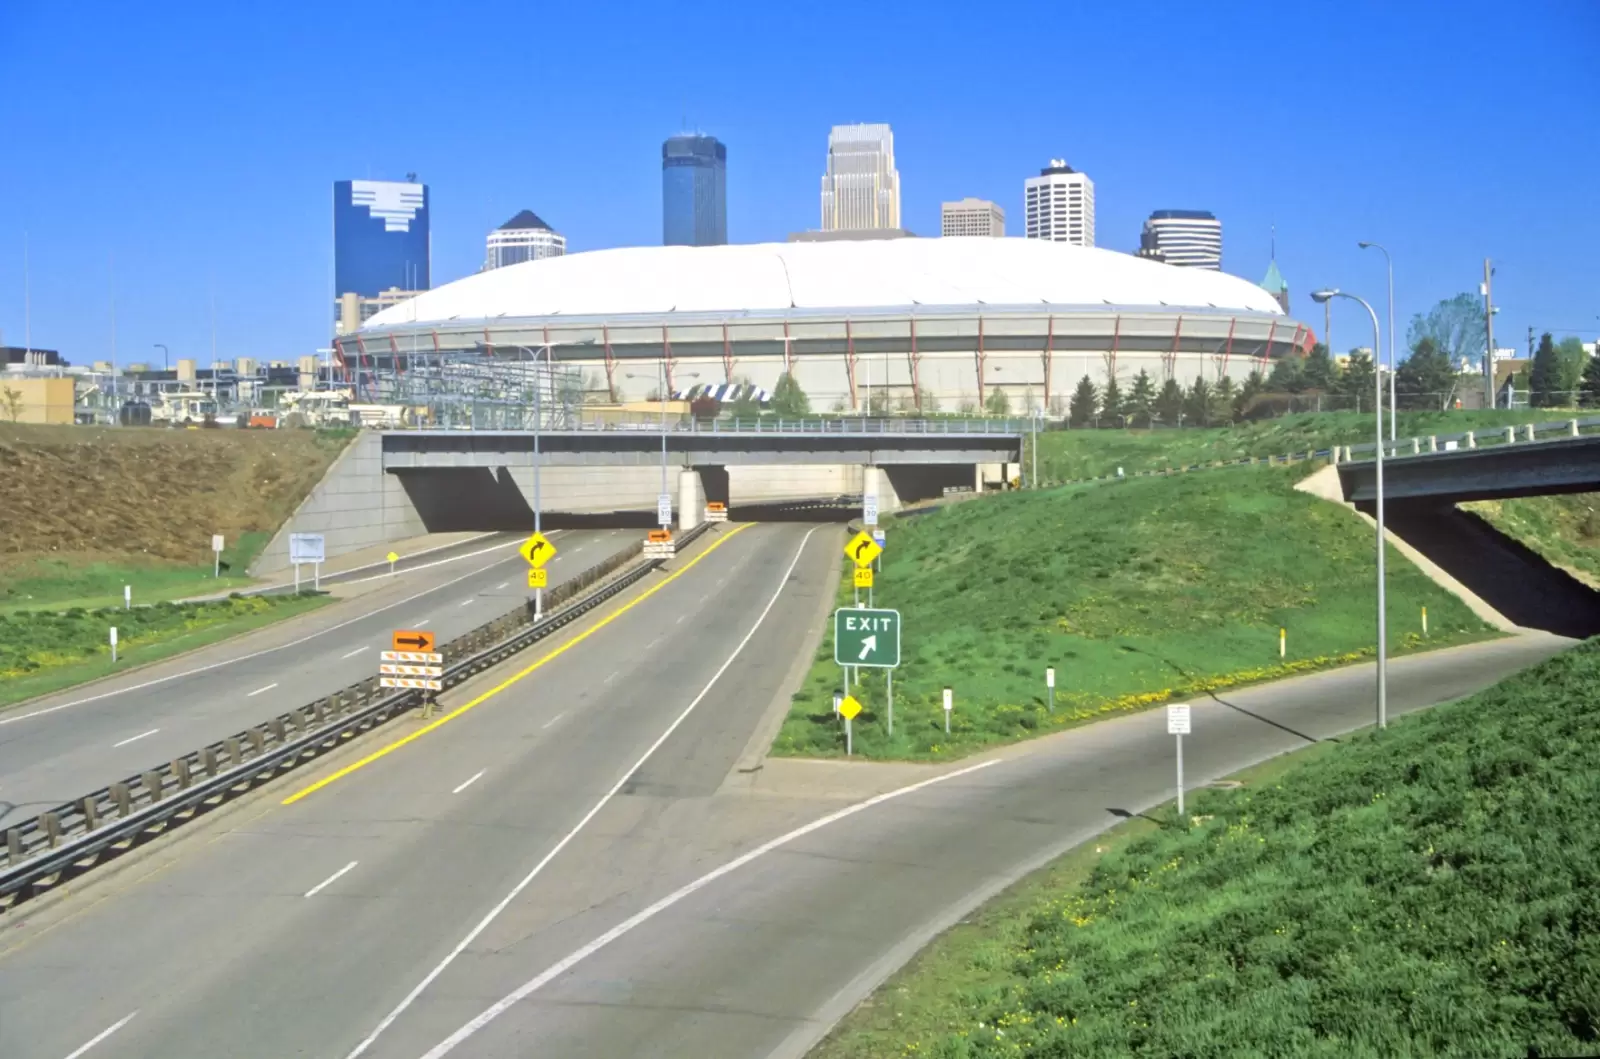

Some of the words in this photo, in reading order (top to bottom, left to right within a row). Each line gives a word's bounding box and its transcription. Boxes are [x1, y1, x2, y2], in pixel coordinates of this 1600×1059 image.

[530, 571, 545, 580] 40
[855, 571, 871, 580] 40
[846, 616, 892, 632] EXIT
